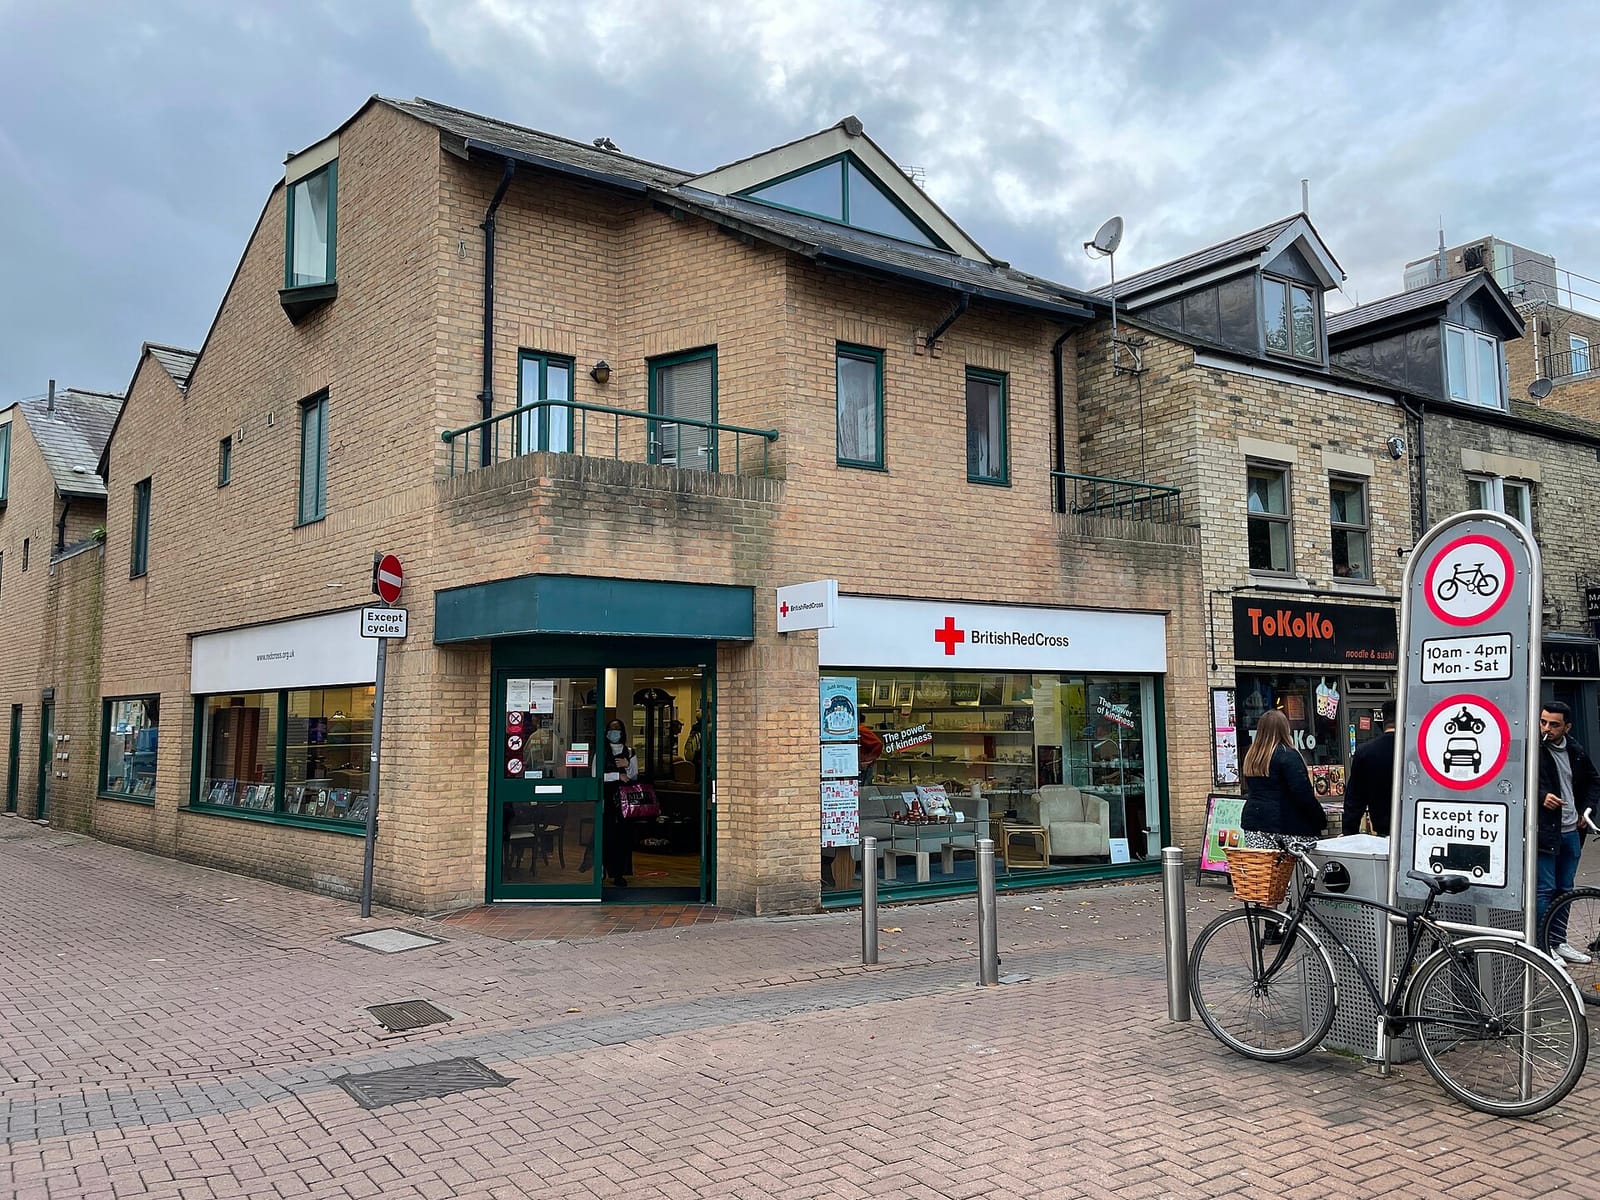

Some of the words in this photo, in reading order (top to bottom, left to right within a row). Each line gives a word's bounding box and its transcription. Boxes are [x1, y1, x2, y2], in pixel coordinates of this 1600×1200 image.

[367, 612, 404, 623] Except
[367, 624, 400, 633] cycles
[971, 630, 1069, 647] BritishRedCross
[1345, 650, 1369, 658] noodle
[1370, 650, 1376, 659] &
[1377, 651, 1395, 660] sushi
[1426, 647, 1462, 659] 10am
[1474, 644, 1507, 658] 4pm
[1433, 662, 1461, 674] Mon
[1474, 660, 1499, 671] Sat
[1098, 695, 1112, 709] The
[1112, 704, 1133, 718] power
[1105, 708, 1135, 728] kindness
[882, 732, 900, 744] The
[901, 723, 926, 739] power
[885, 743, 895, 753] of
[896, 732, 933, 751] kindness
[1423, 807, 1473, 824] Except
[1478, 810, 1499, 823] for
[1422, 823, 1475, 841] loading
[1480, 826, 1498, 842] by
